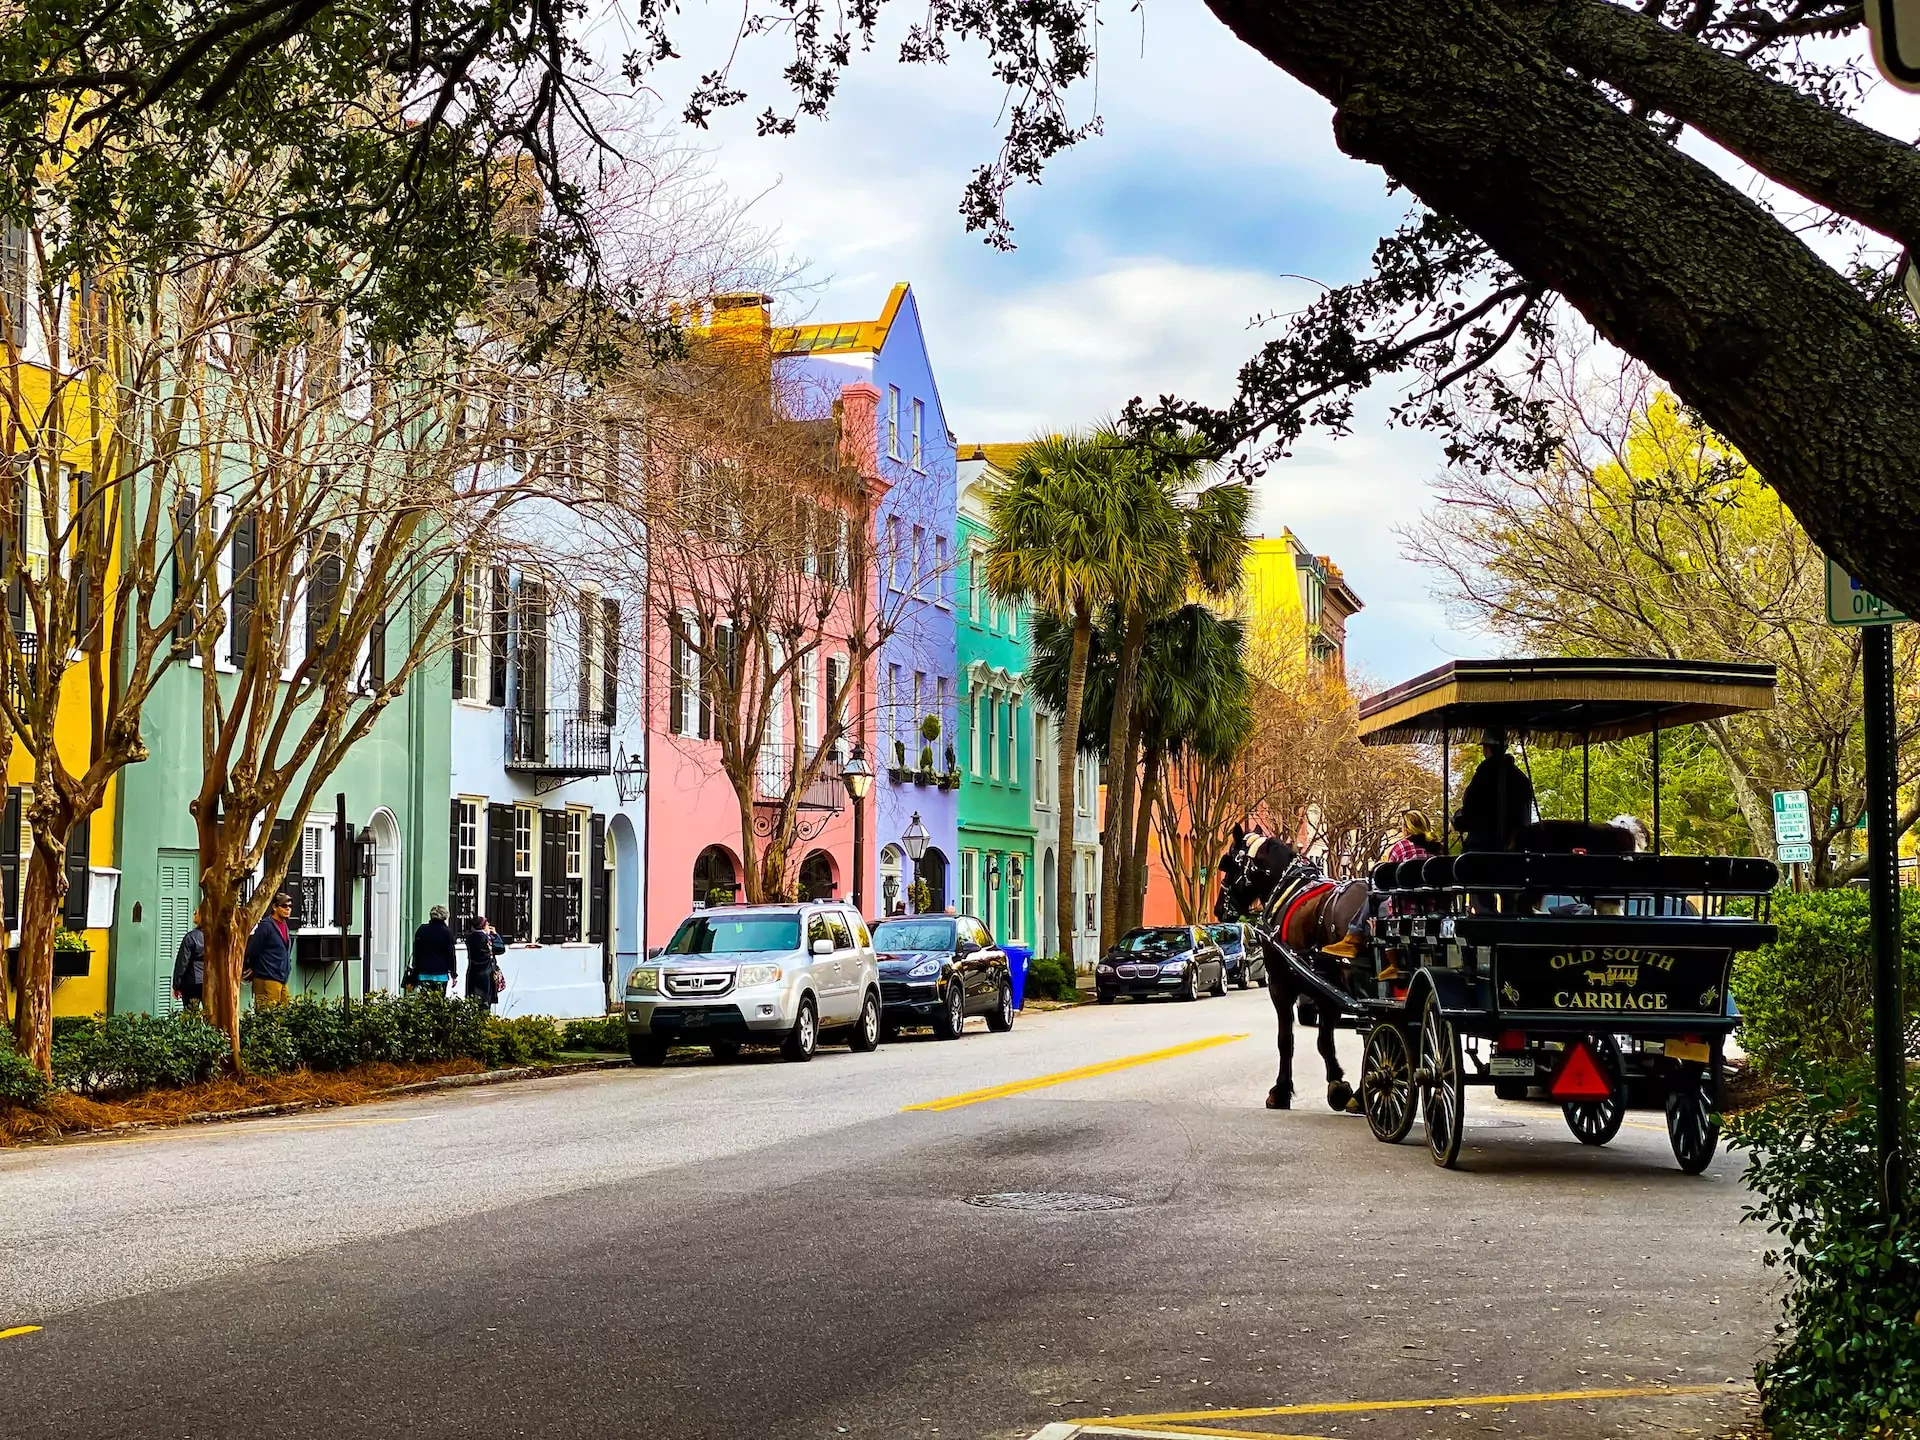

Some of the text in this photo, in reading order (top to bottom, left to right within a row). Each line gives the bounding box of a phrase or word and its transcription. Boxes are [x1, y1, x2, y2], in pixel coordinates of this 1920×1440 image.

[1853, 594, 1891, 614] ONL
[1550, 948, 1675, 971] OLD SOUTH
[1553, 991, 1668, 1010] CARRIAGE
[1514, 1057, 1533, 1068] 338
